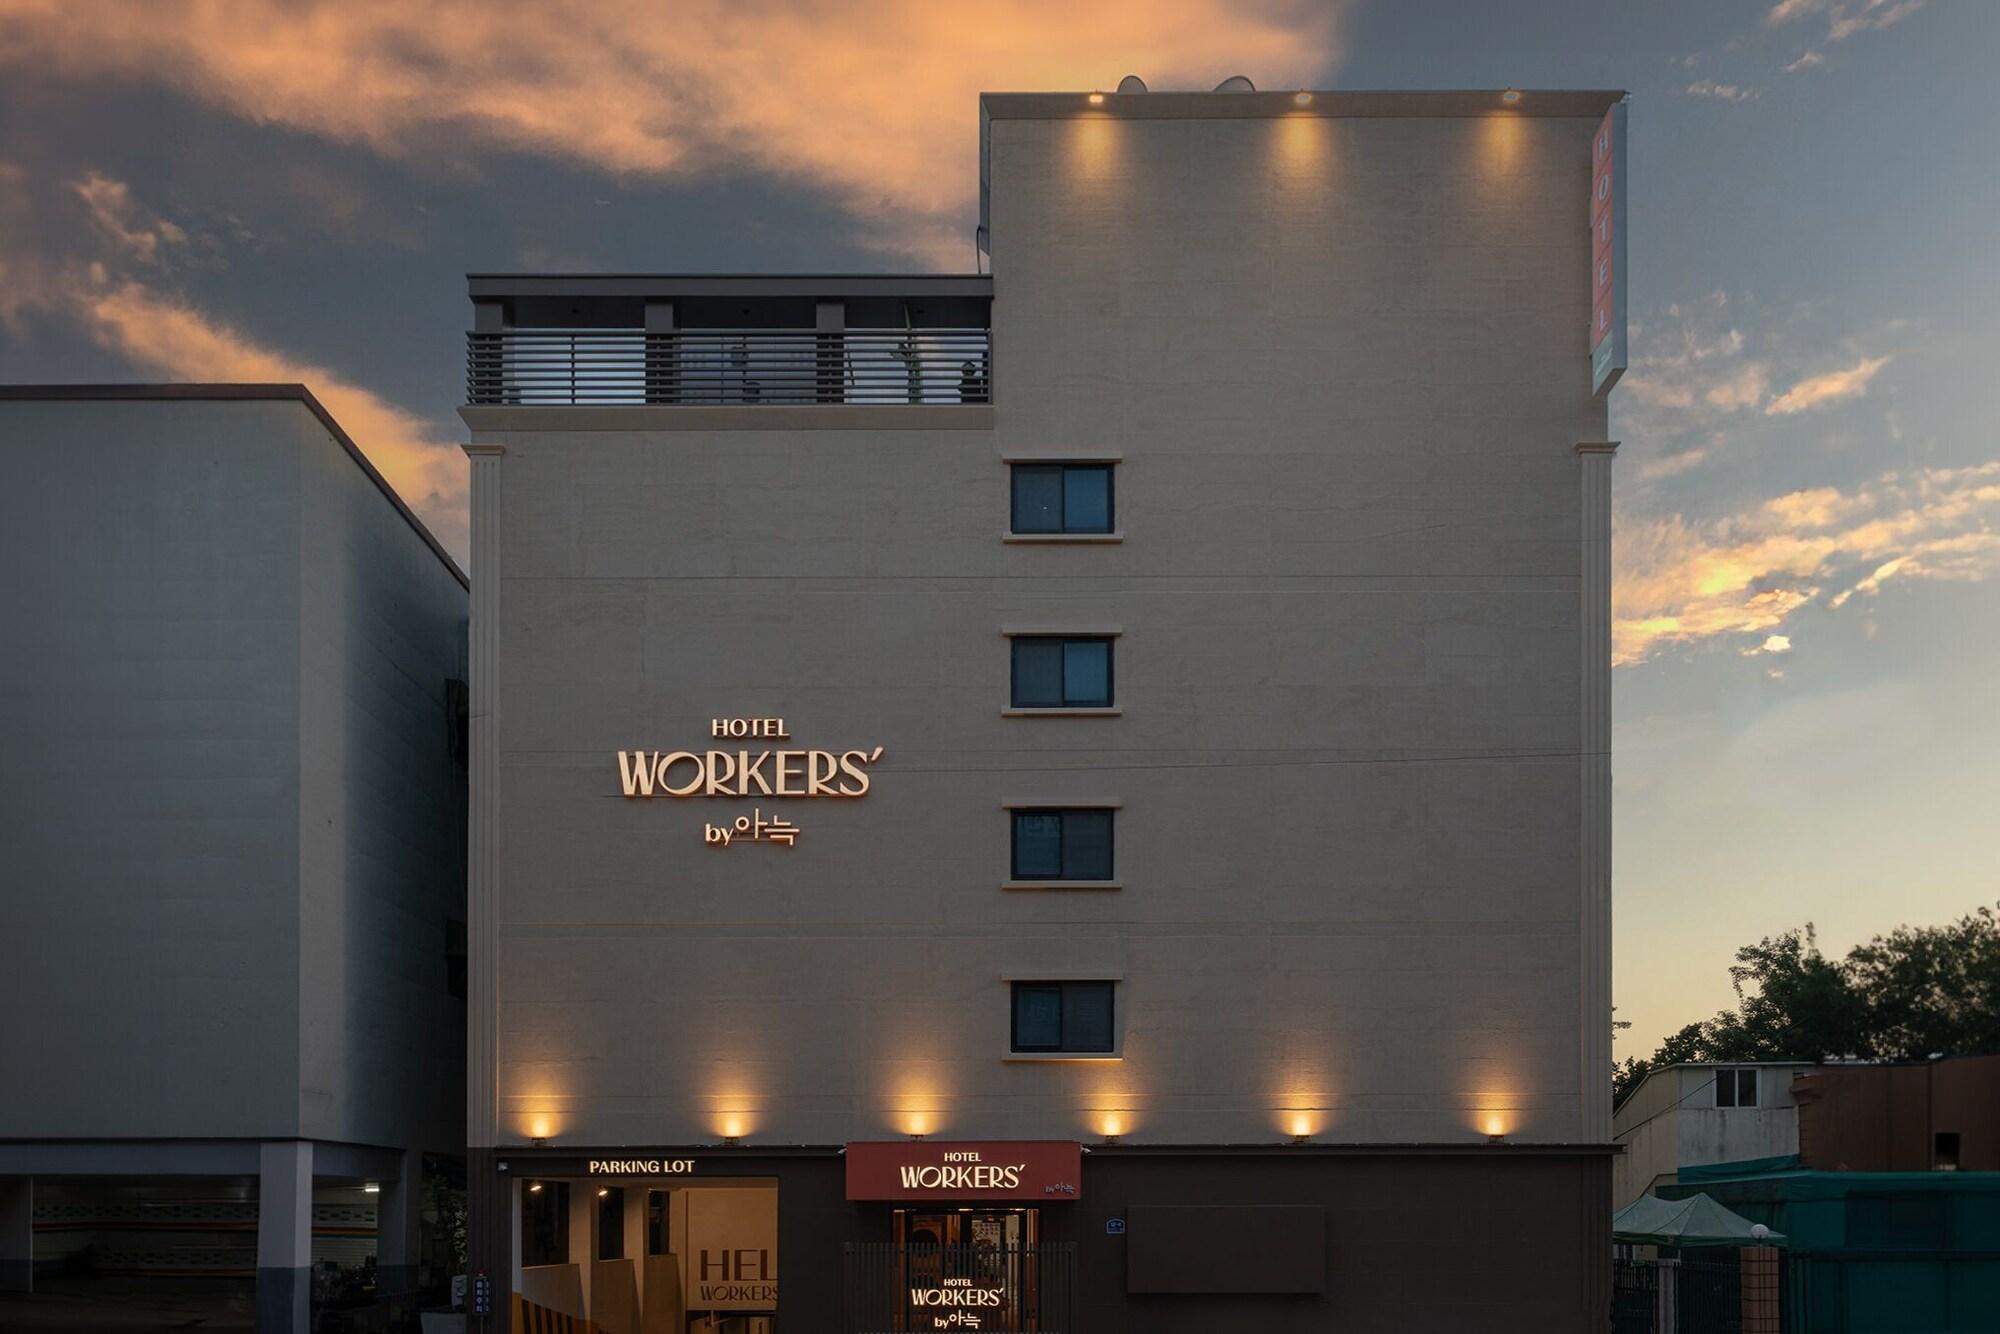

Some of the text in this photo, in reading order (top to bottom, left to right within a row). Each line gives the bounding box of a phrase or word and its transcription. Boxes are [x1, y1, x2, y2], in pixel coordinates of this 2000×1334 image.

[711, 718, 790, 737] HOTEL
[617, 746, 884, 797] WORKERS'
[944, 1152, 982, 1162] HOTEL
[589, 1160, 696, 1174] PARKING LOT
[900, 1164, 1026, 1189] WORKERS'
[943, 1278, 973, 1287] HOTEL
